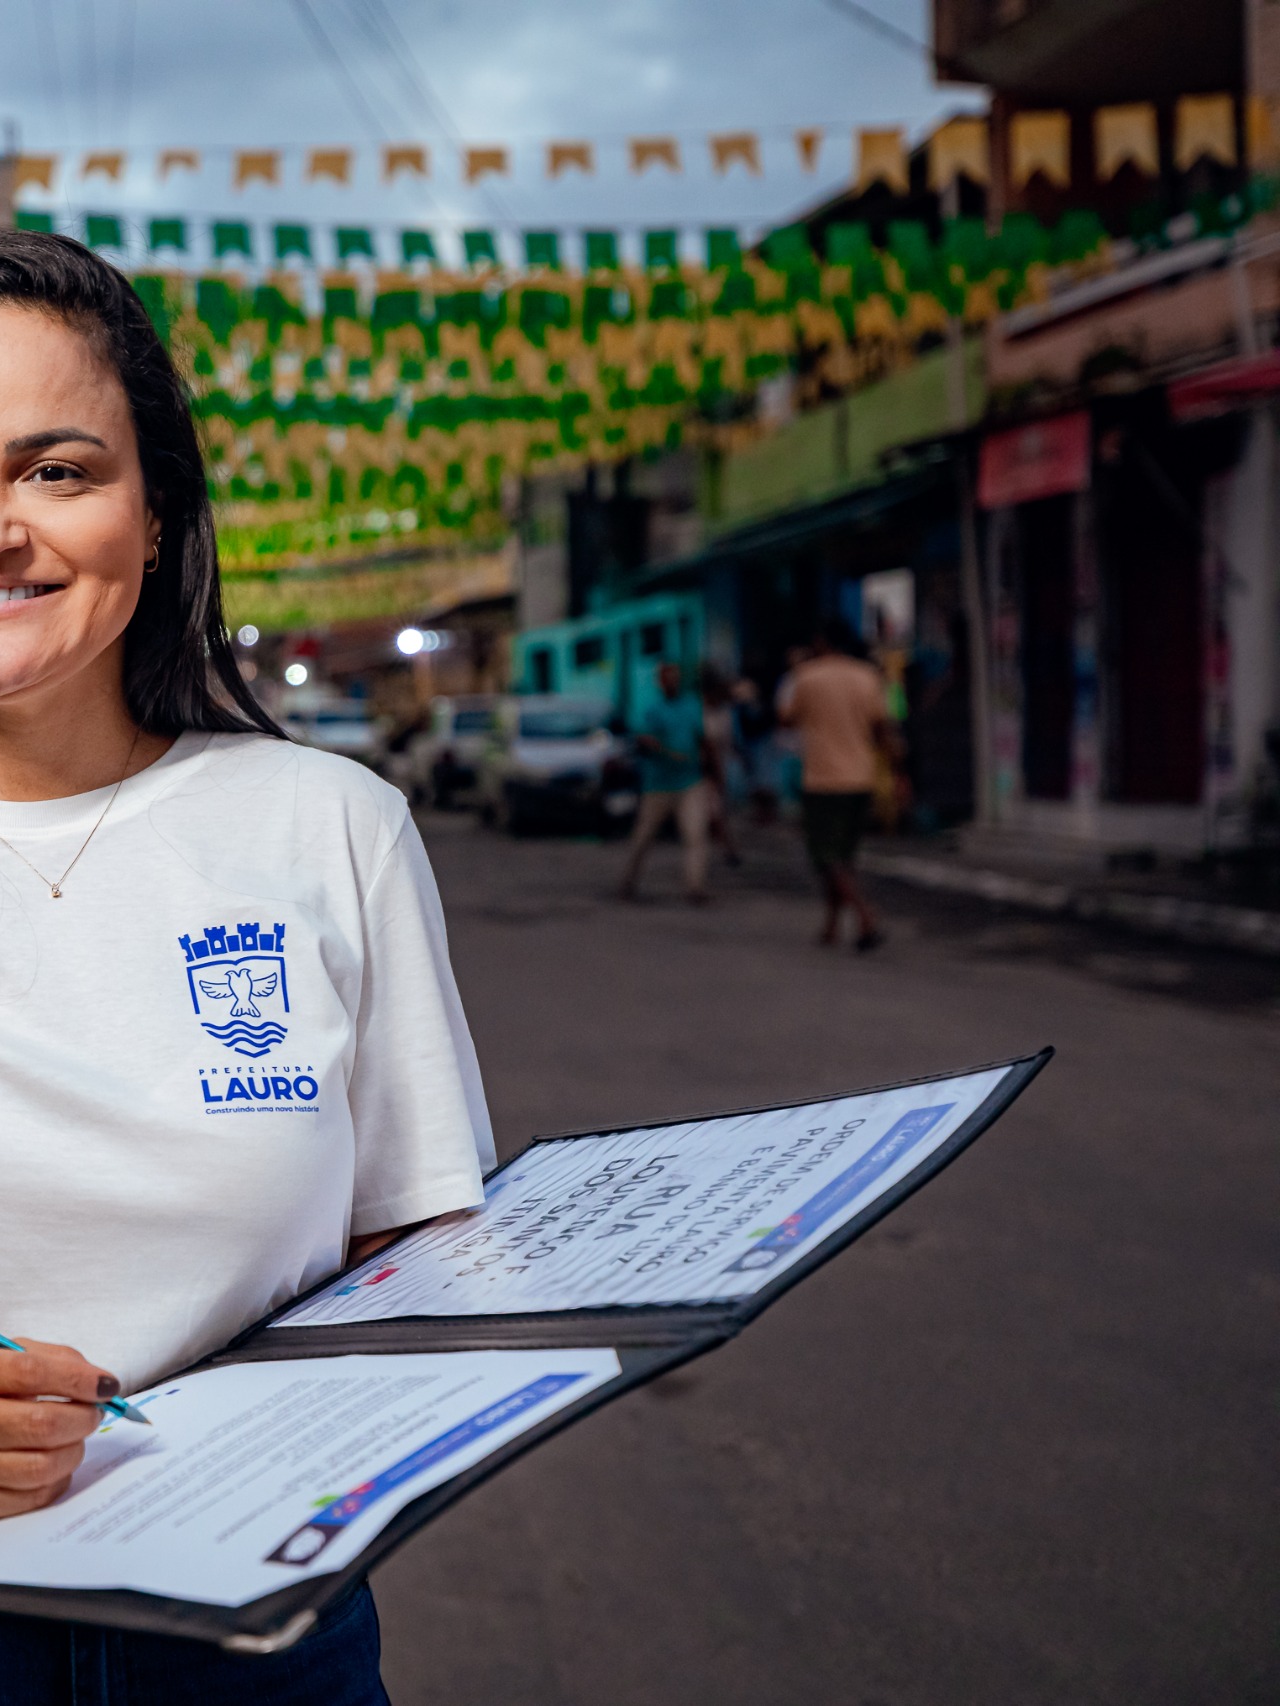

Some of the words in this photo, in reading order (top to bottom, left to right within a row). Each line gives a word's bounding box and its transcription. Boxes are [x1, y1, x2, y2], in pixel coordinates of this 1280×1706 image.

[199, 1065, 314, 1075] PREFEITURA
[201, 1075, 319, 1103] LAURO
[205, 1106, 256, 1115] Construindo
[294, 1105, 320, 1114] história
[701, 1126, 829, 1218] PAVIMENTA
[750, 1145, 777, 1156] E
[789, 1118, 868, 1175] ORDEM
[566, 1157, 637, 1199] DOS
[680, 1157, 763, 1211] BANHO
[762, 1177, 802, 1197] DE
[438, 1197, 548, 1262] ITINGA
[521, 1154, 681, 1260] LOURENÇO
[593, 1183, 693, 1241] RUA
[651, 1214, 691, 1235] DE
[680, 1199, 774, 1265] SERVIÇO
[453, 1203, 579, 1277] SANTOS
[608, 1237, 661, 1266] LUZ
[633, 1219, 716, 1274] LAURO
